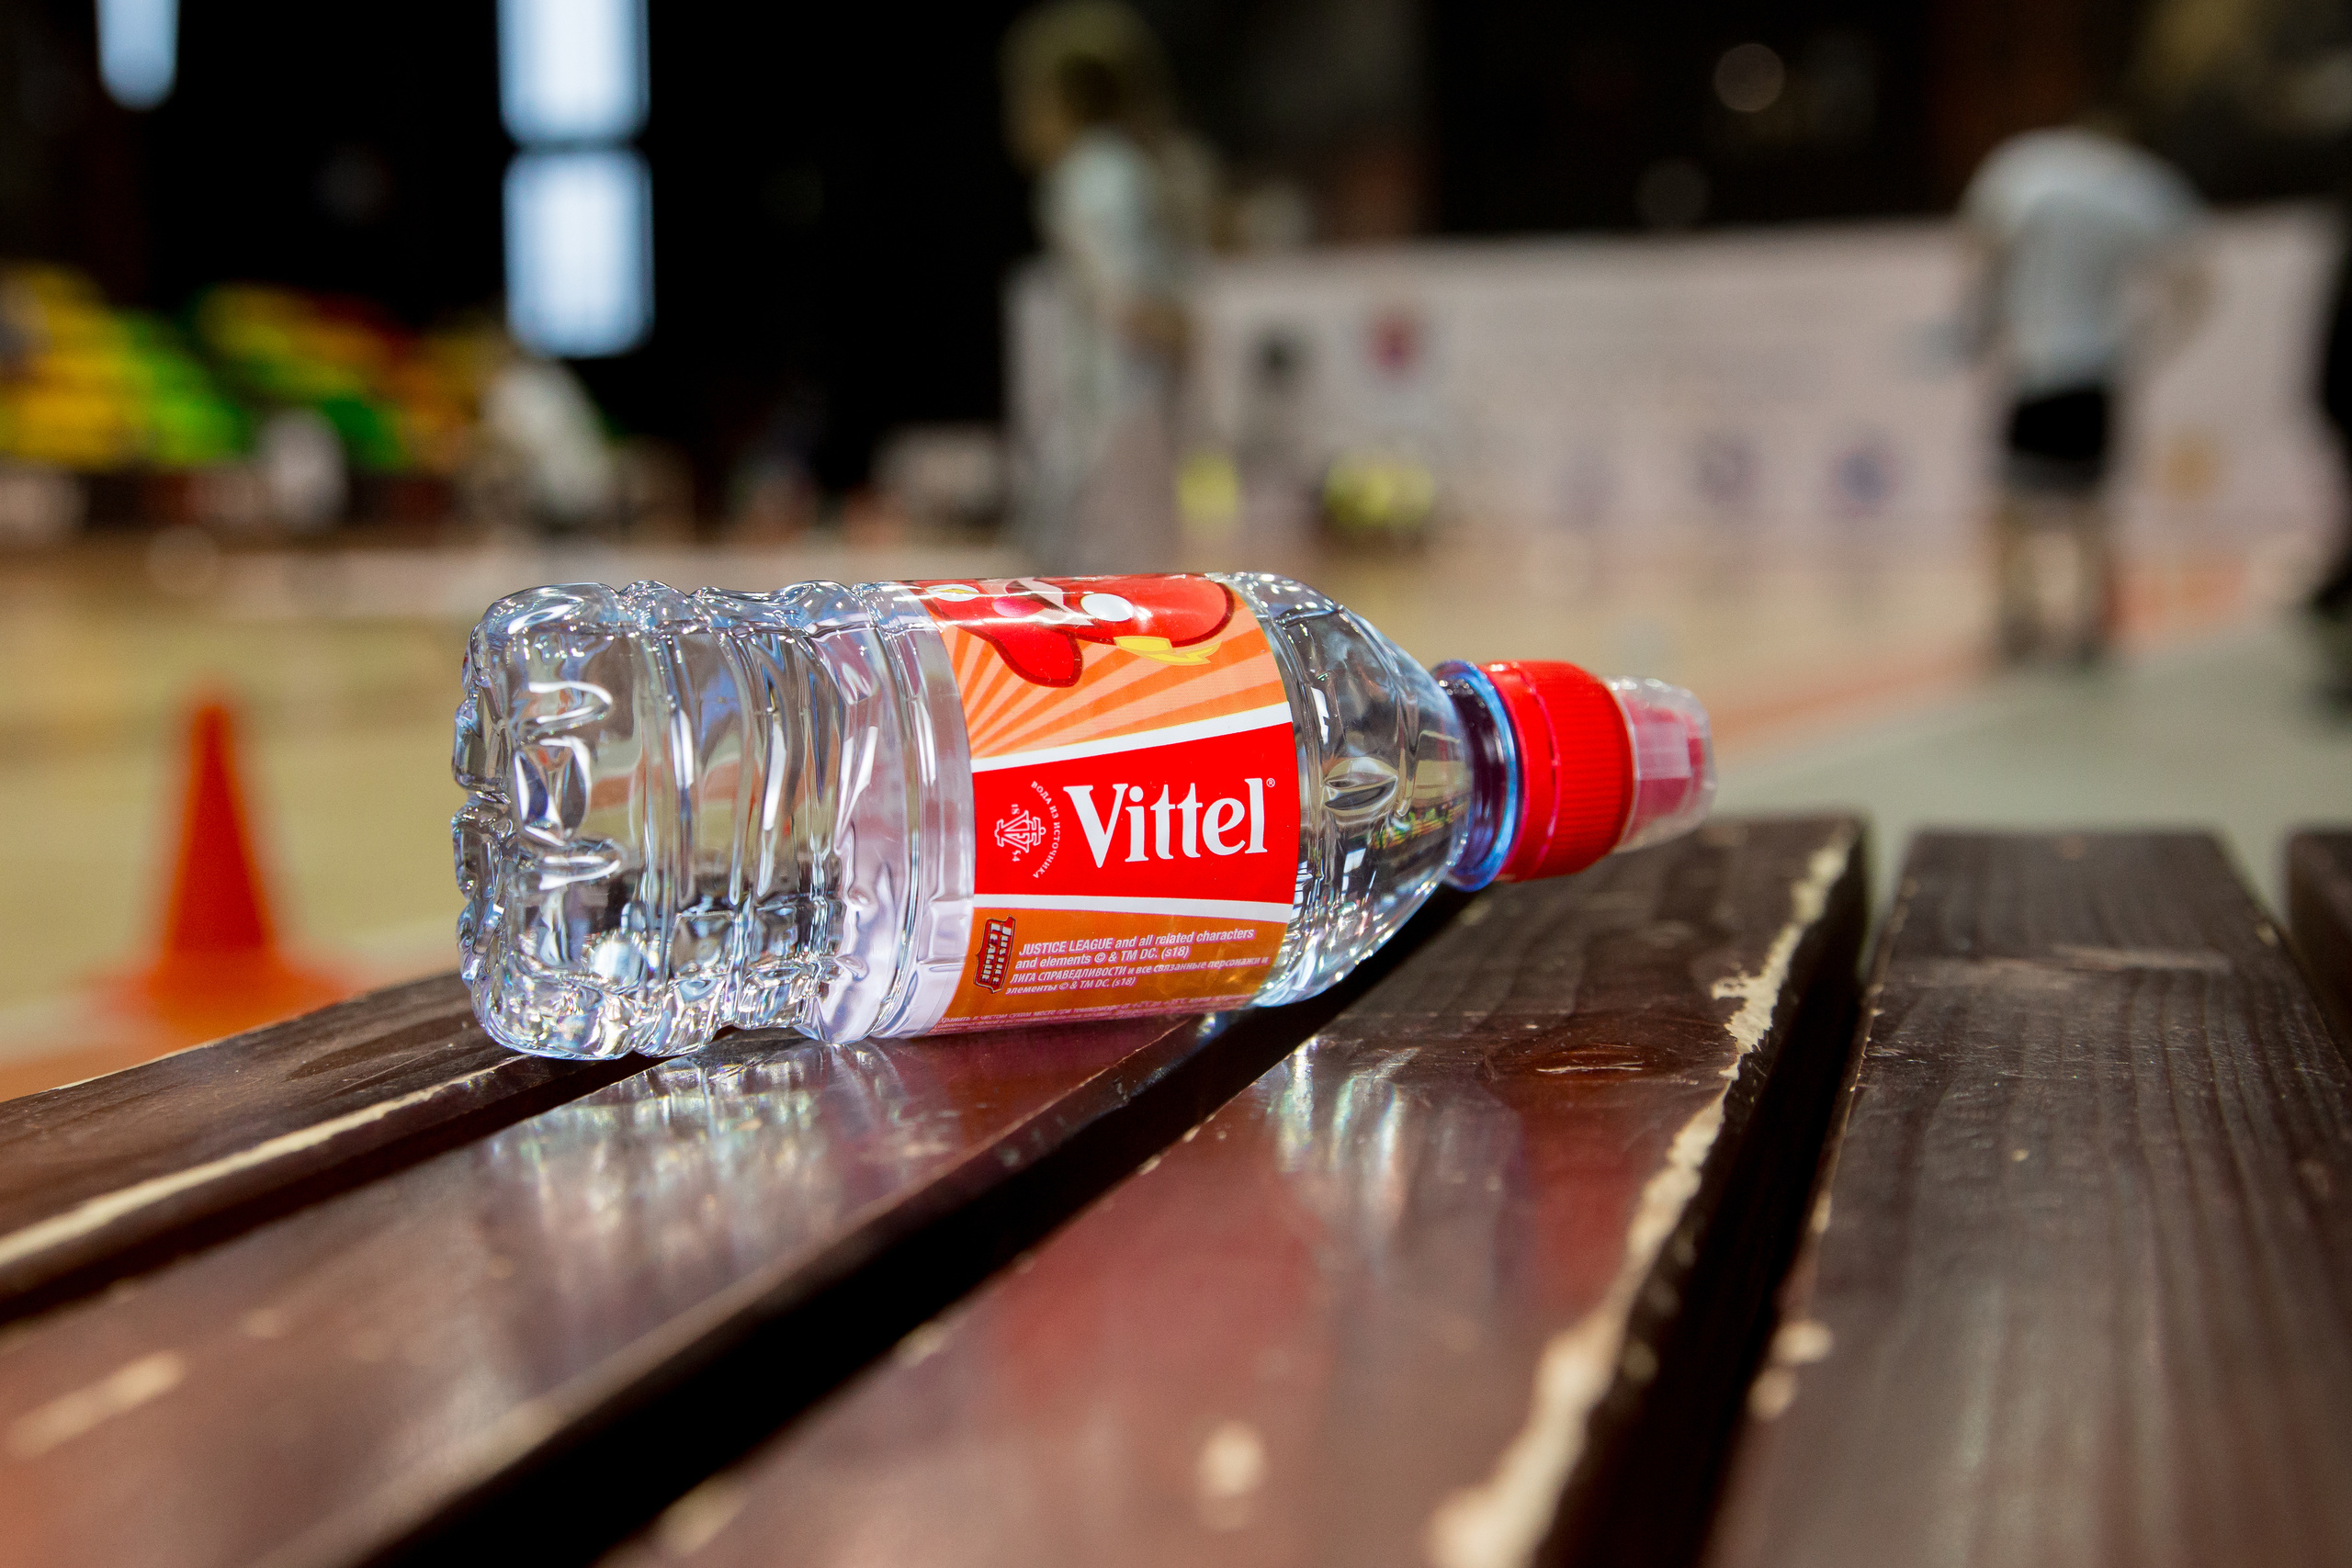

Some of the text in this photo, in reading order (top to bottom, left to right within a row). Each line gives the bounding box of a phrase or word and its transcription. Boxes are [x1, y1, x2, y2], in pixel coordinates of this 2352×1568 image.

[1031, 781, 1060, 878] ВОДА ИЗ ИСТОЧНИКА
[1018, 928, 1255, 956] JUSTICE LEAGUE and all related characters
[1009, 972, 1036, 984] ЛИГА
[1037, 965, 1127, 982] СПРАВЕДЛИВОСТИ
[1136, 965, 1152, 974] все
[1153, 961, 1207, 973] связанные
[1207, 957, 1260, 970] персонажи
[1014, 956, 1038, 970] and
[1039, 953, 1091, 968] elements
[1107, 951, 1118, 963] &
[1120, 949, 1138, 962] TM
[1139, 947, 1159, 960] DC.
[1160, 945, 1190, 959] (s18)
[1005, 984, 1057, 995] элементы
[1069, 980, 1079, 989] &
[1080, 979, 1094, 989] TM
[1094, 978, 1111, 988] DC.
[1112, 976, 1136, 987] (s18)
